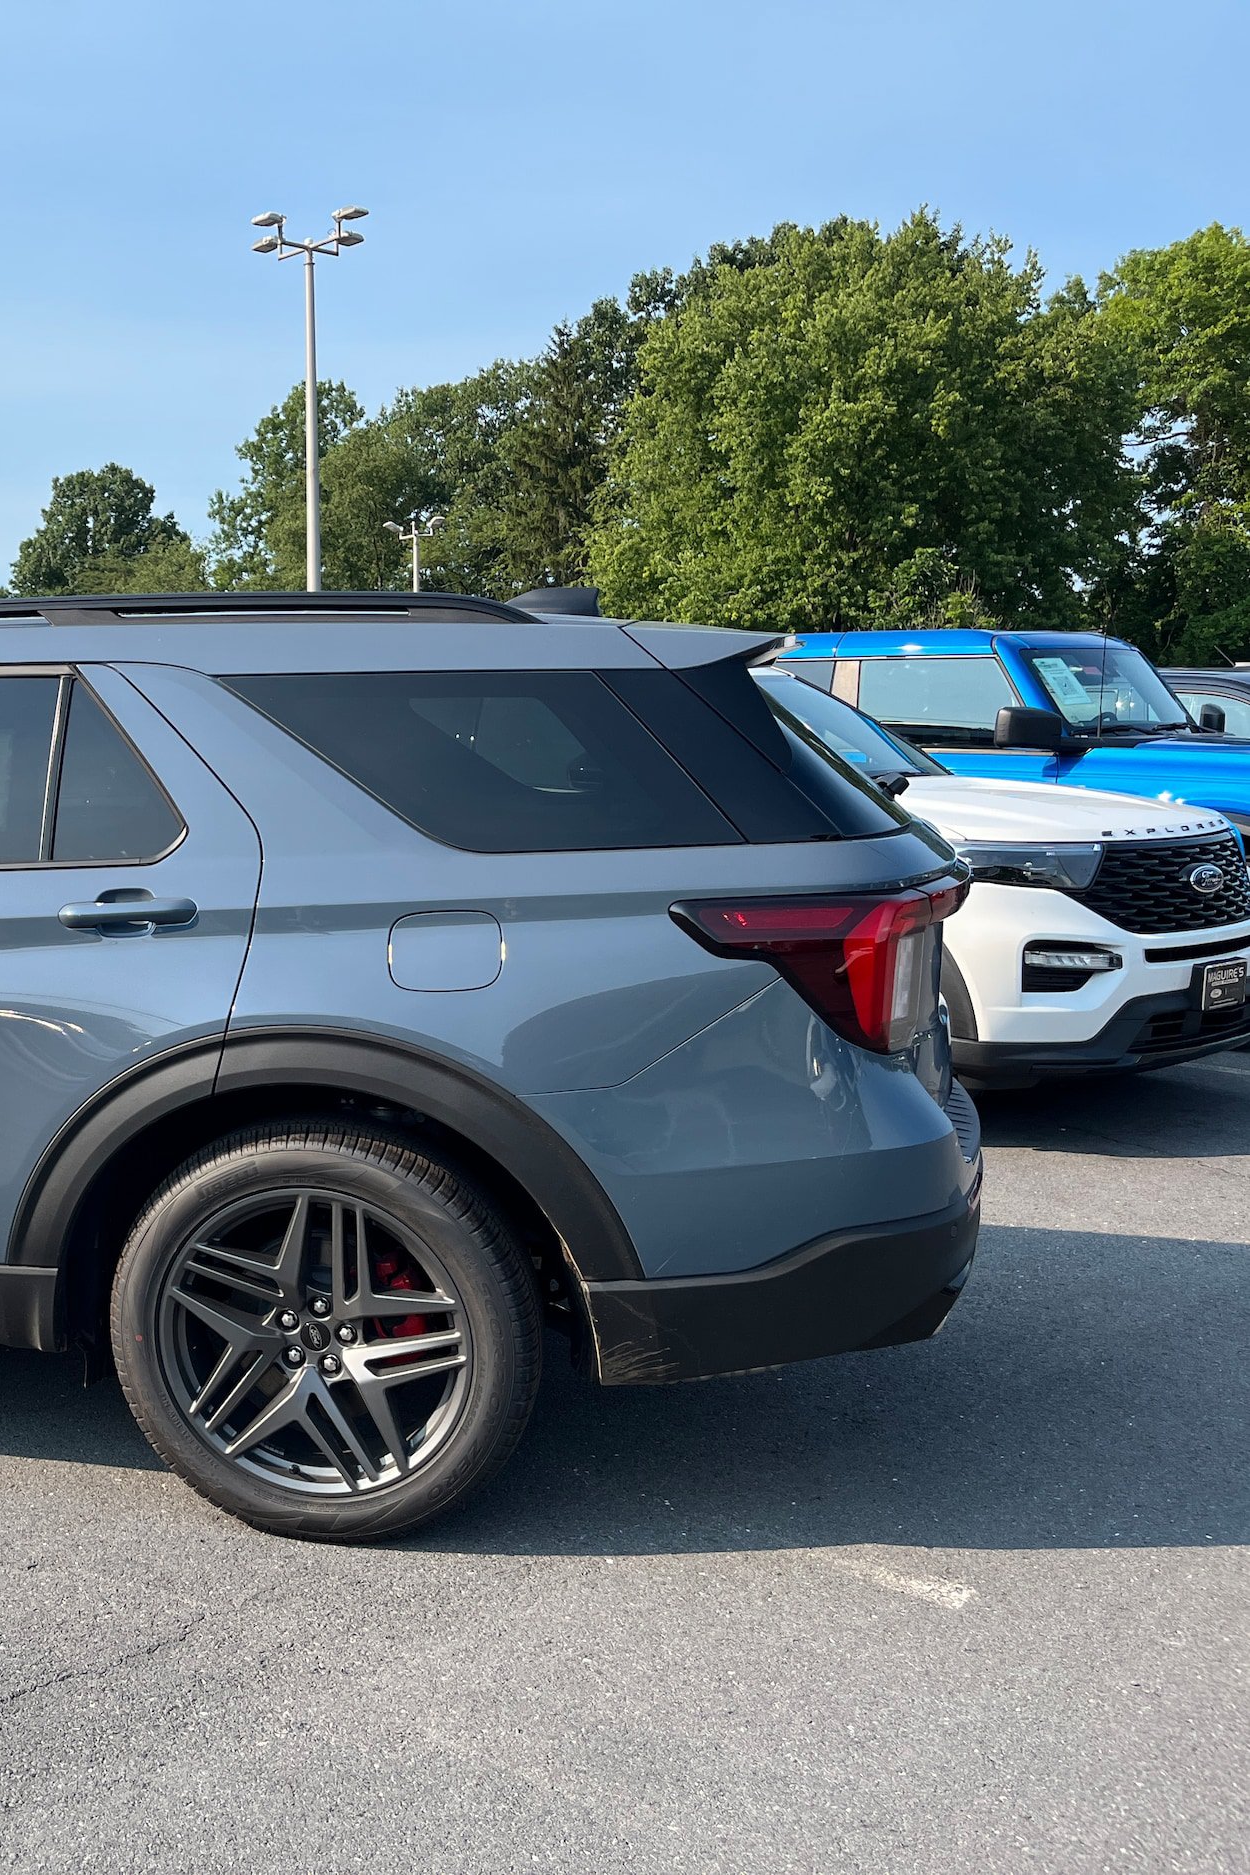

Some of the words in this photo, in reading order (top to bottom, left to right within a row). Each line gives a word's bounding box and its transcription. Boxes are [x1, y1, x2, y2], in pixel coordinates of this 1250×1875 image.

[1101, 819, 1225, 836] EXPLORER
[1207, 966, 1244, 982] MAGUIRE'S
[427, 1439, 483, 1501] ZERO
